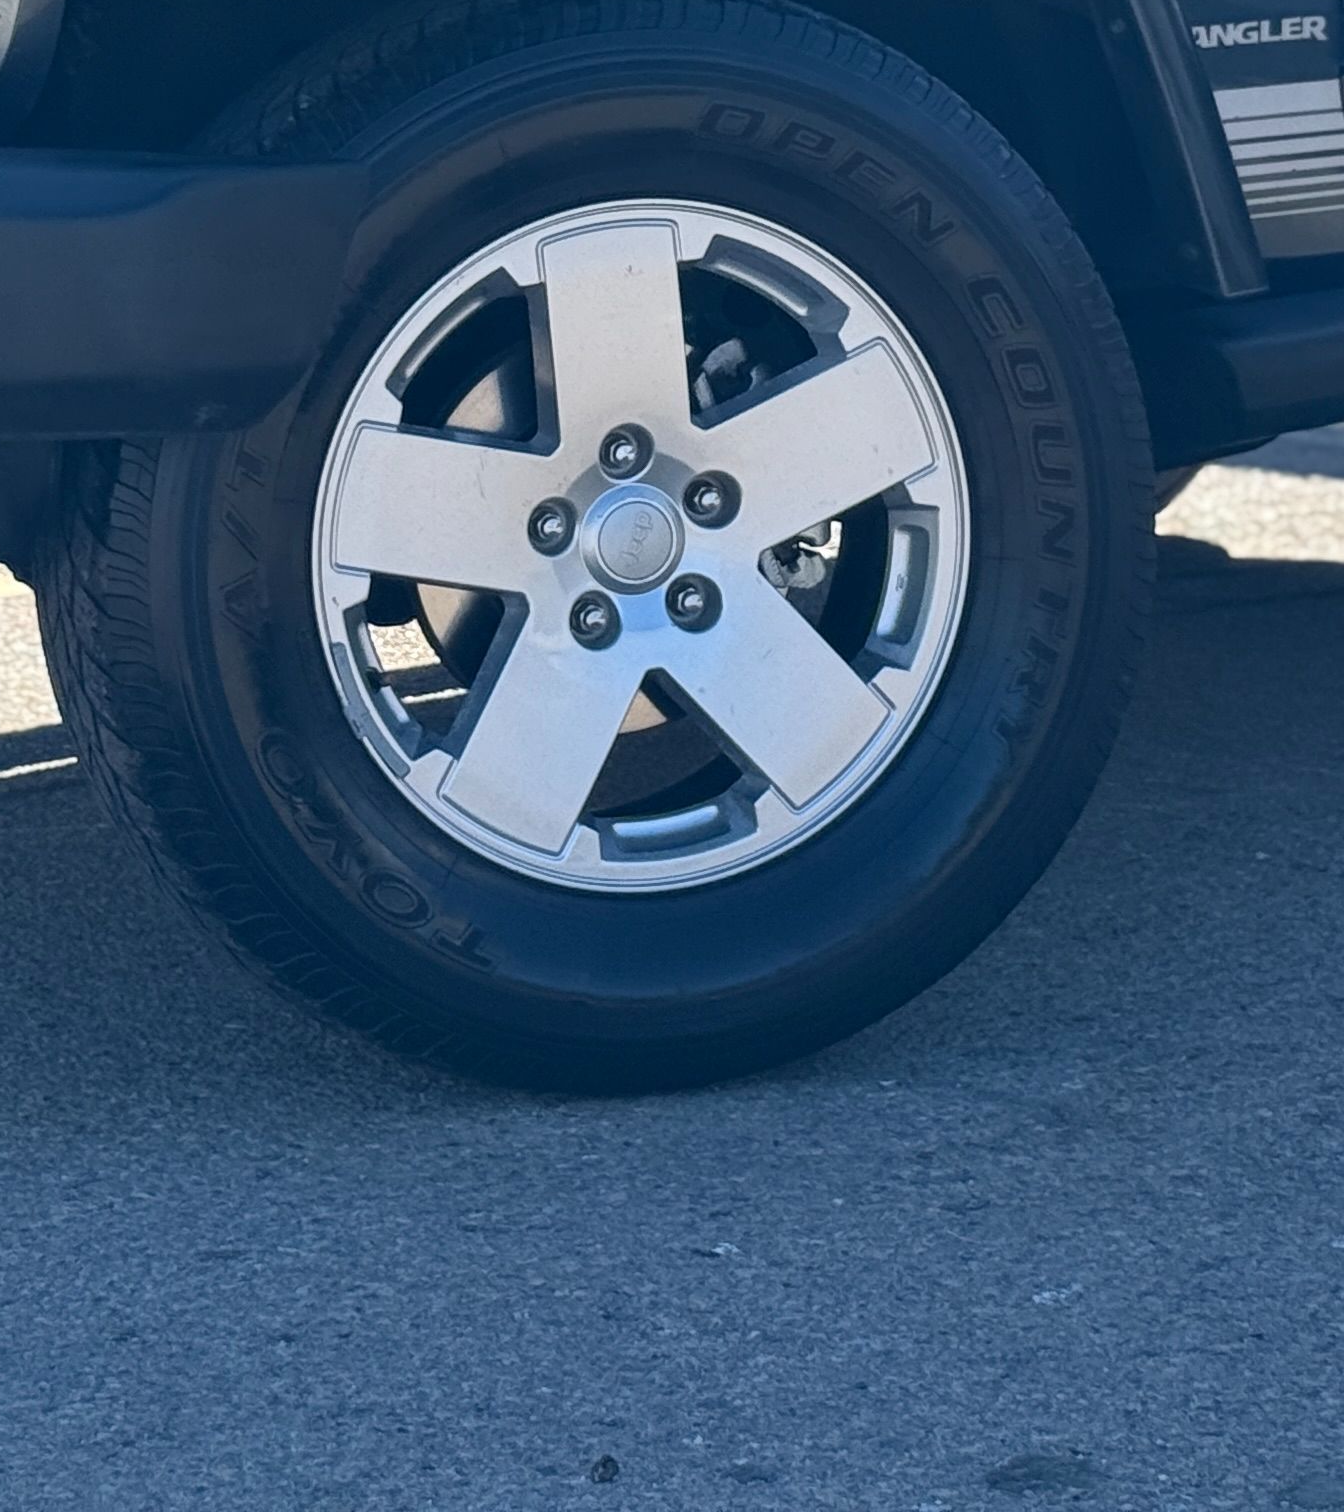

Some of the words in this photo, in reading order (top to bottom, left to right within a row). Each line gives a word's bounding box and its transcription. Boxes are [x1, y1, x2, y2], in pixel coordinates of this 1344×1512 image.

[1191, 16, 1328, 48] ANGLER
[699, 103, 954, 248] OPEN
[964, 272, 1076, 760] COUNTRY
[256, 728, 498, 975] TOYO
